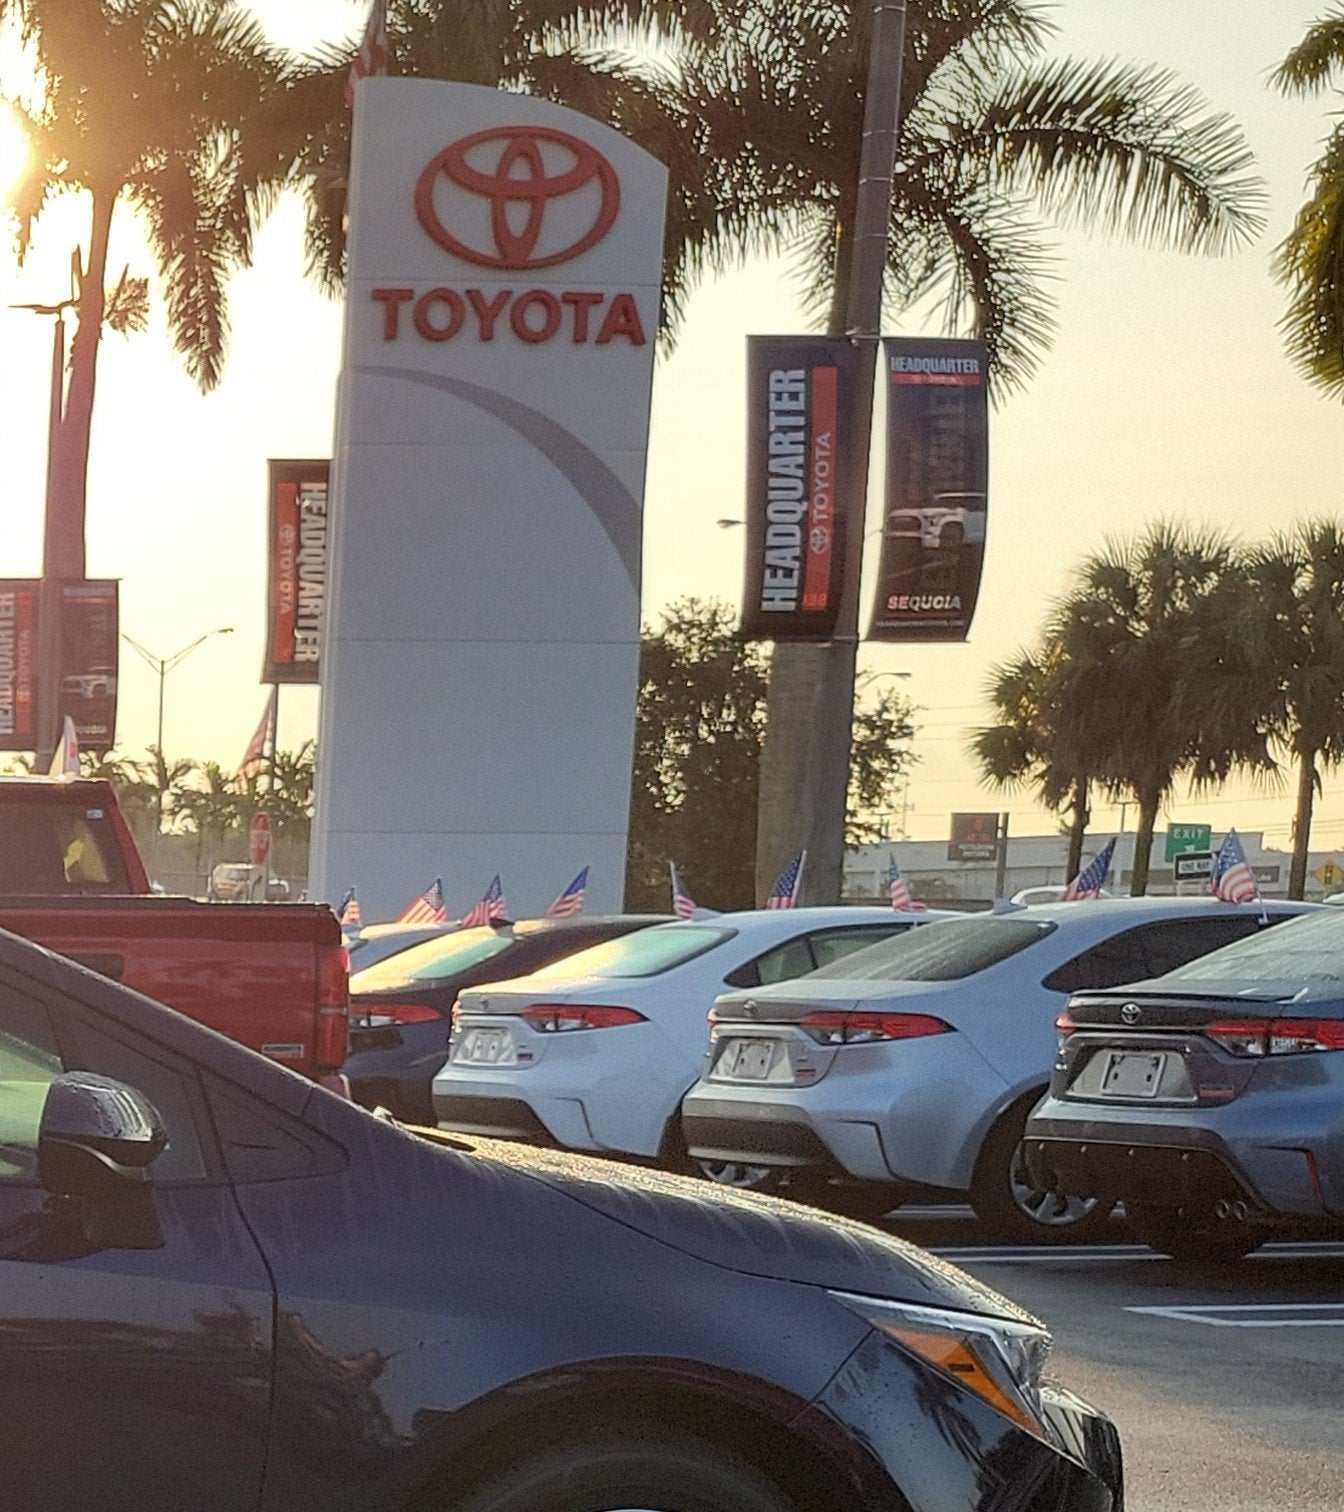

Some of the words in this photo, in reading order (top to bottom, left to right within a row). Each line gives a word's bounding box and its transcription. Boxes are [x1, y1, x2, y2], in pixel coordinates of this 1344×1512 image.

[371, 287, 646, 346] TOYOTA
[891, 357, 979, 374] HEADQUARTER
[762, 368, 808, 612] HEADQUARTER
[812, 433, 833, 524] TOYOTA
[293, 482, 327, 662] HEADQUARTER
[887, 595, 962, 611] SEQUOIA
[1173, 828, 1204, 839] EXIT
